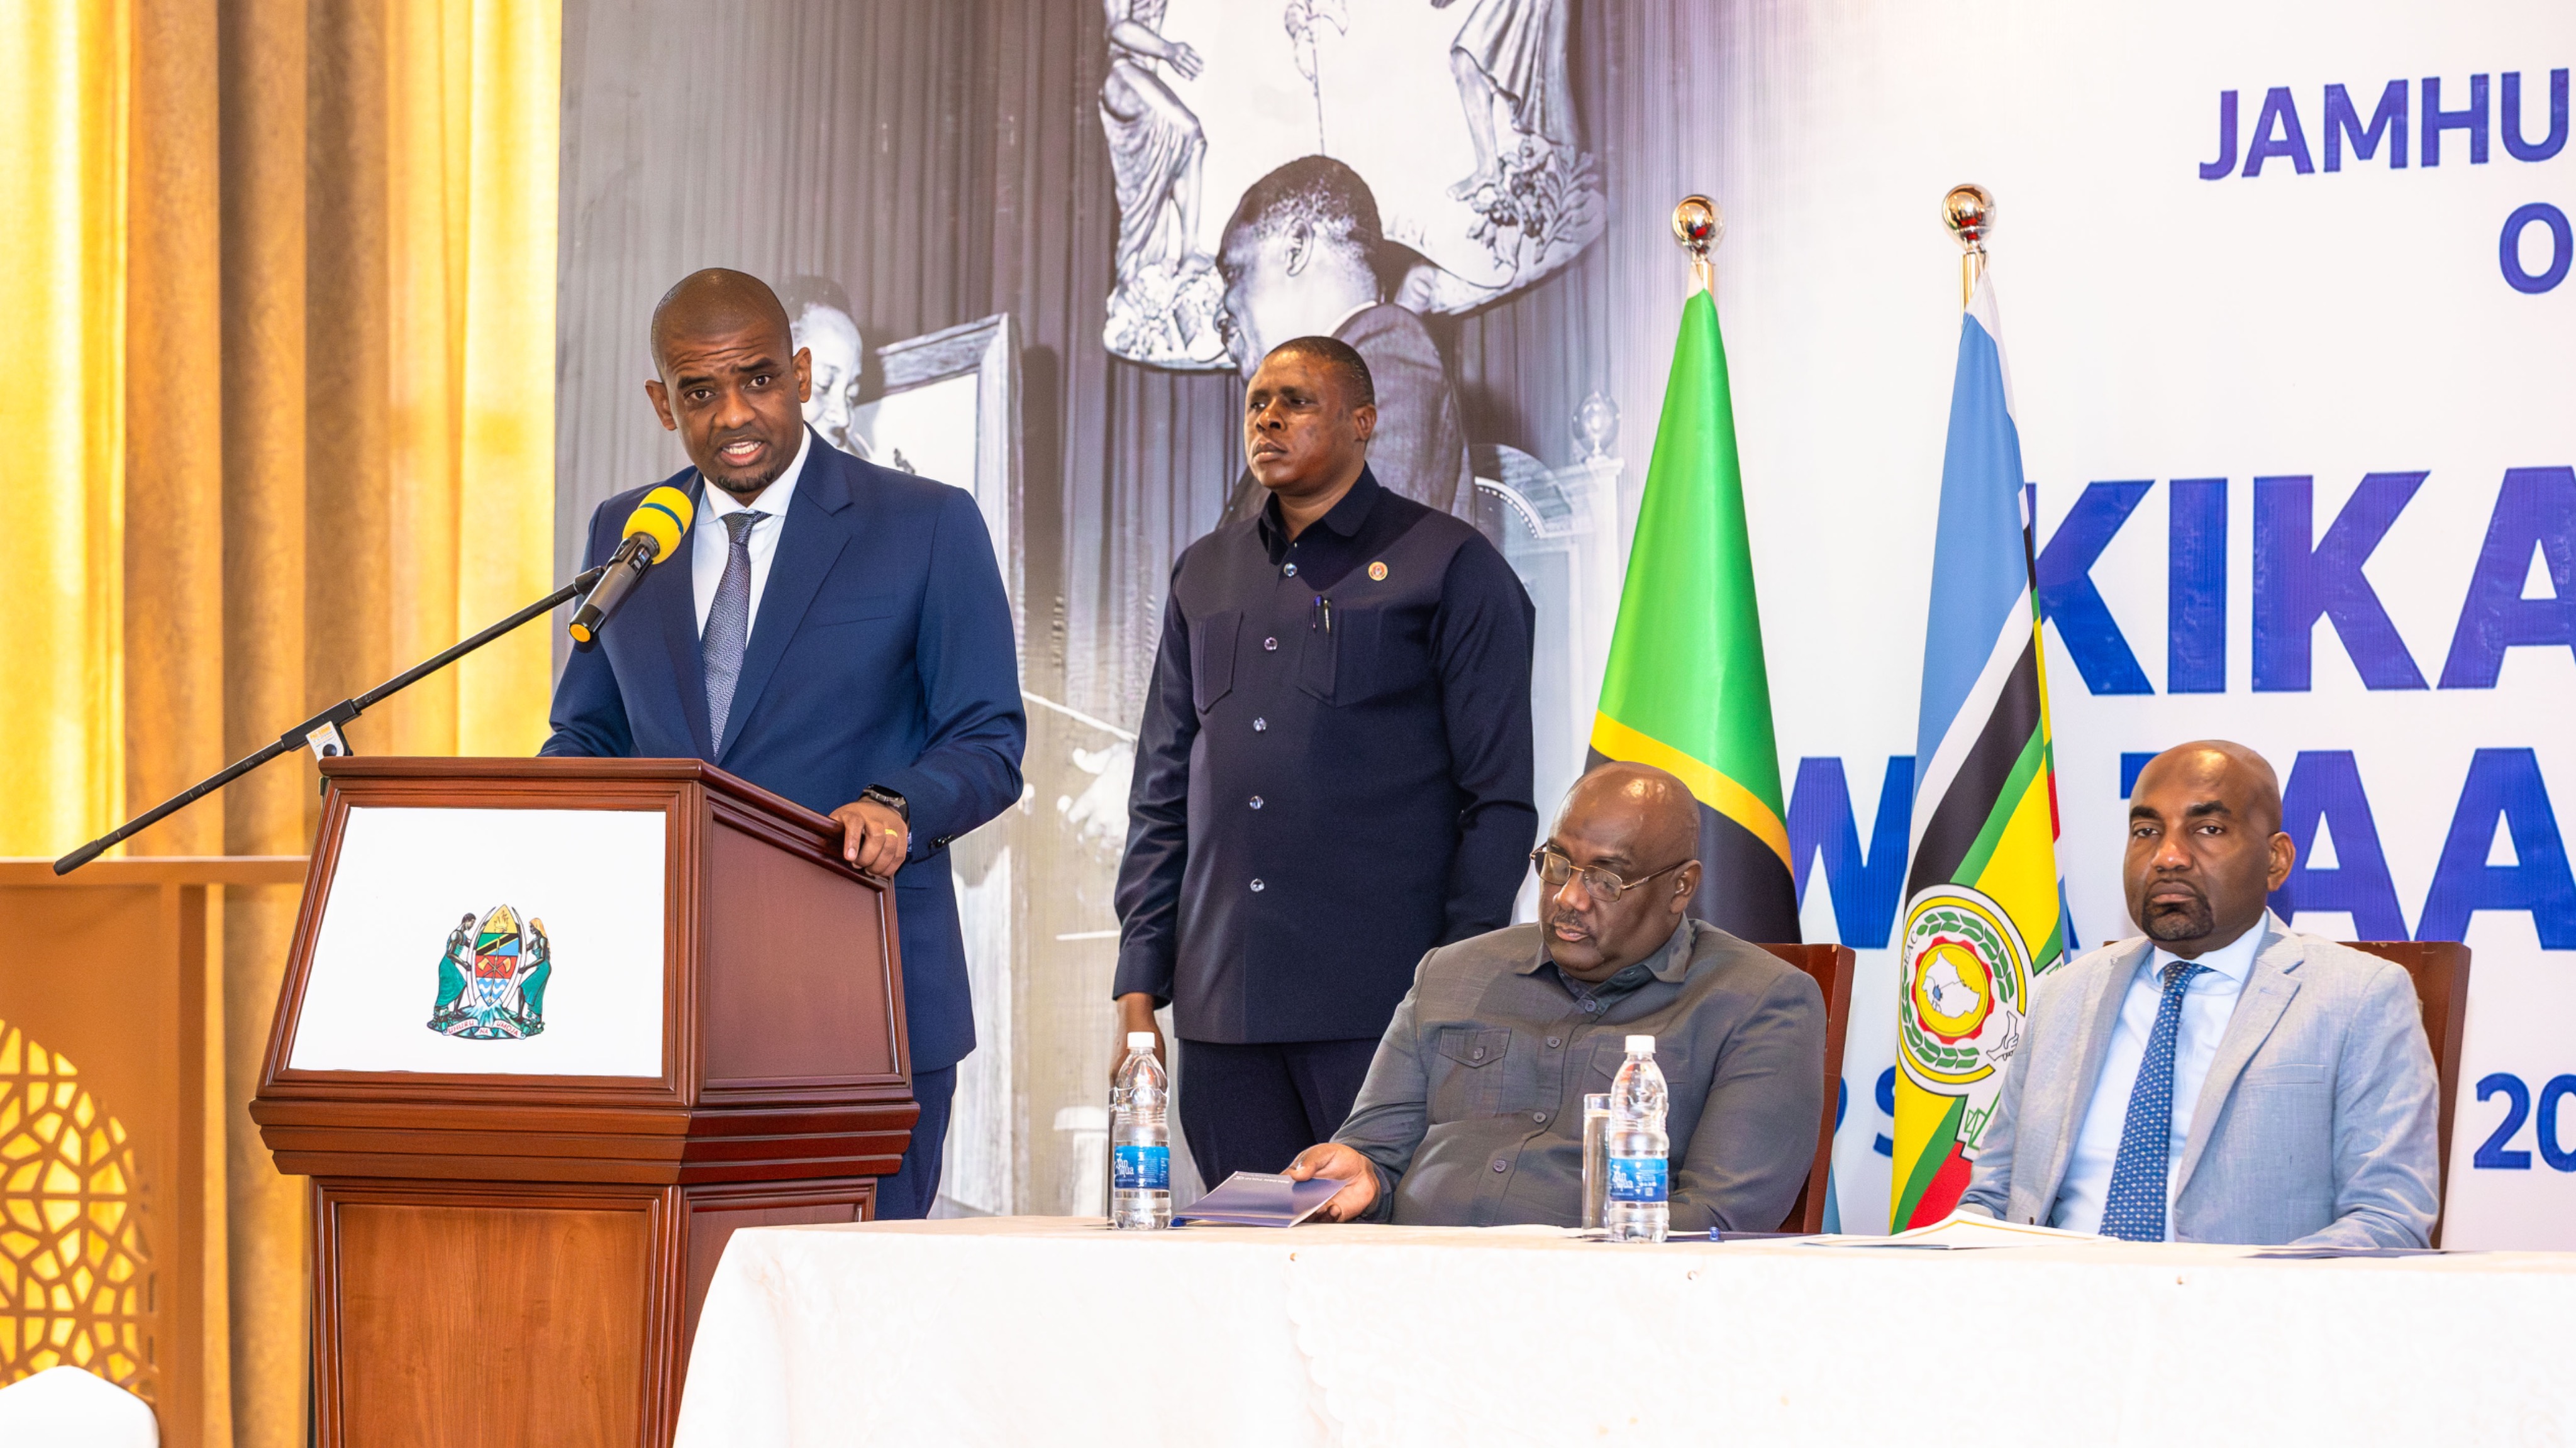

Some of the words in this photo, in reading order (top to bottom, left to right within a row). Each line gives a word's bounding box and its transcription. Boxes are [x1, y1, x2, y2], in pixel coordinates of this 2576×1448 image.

[2199, 68, 2569, 180] JAMHU
[2499, 202, 2574, 294] O
[2024, 466, 2576, 696] KIKA
[2120, 747, 2576, 951] AA
[447, 1020, 474, 1034] UHURU
[496, 1020, 518, 1036] UMOJA
[2473, 1072, 2576, 1172] 20
